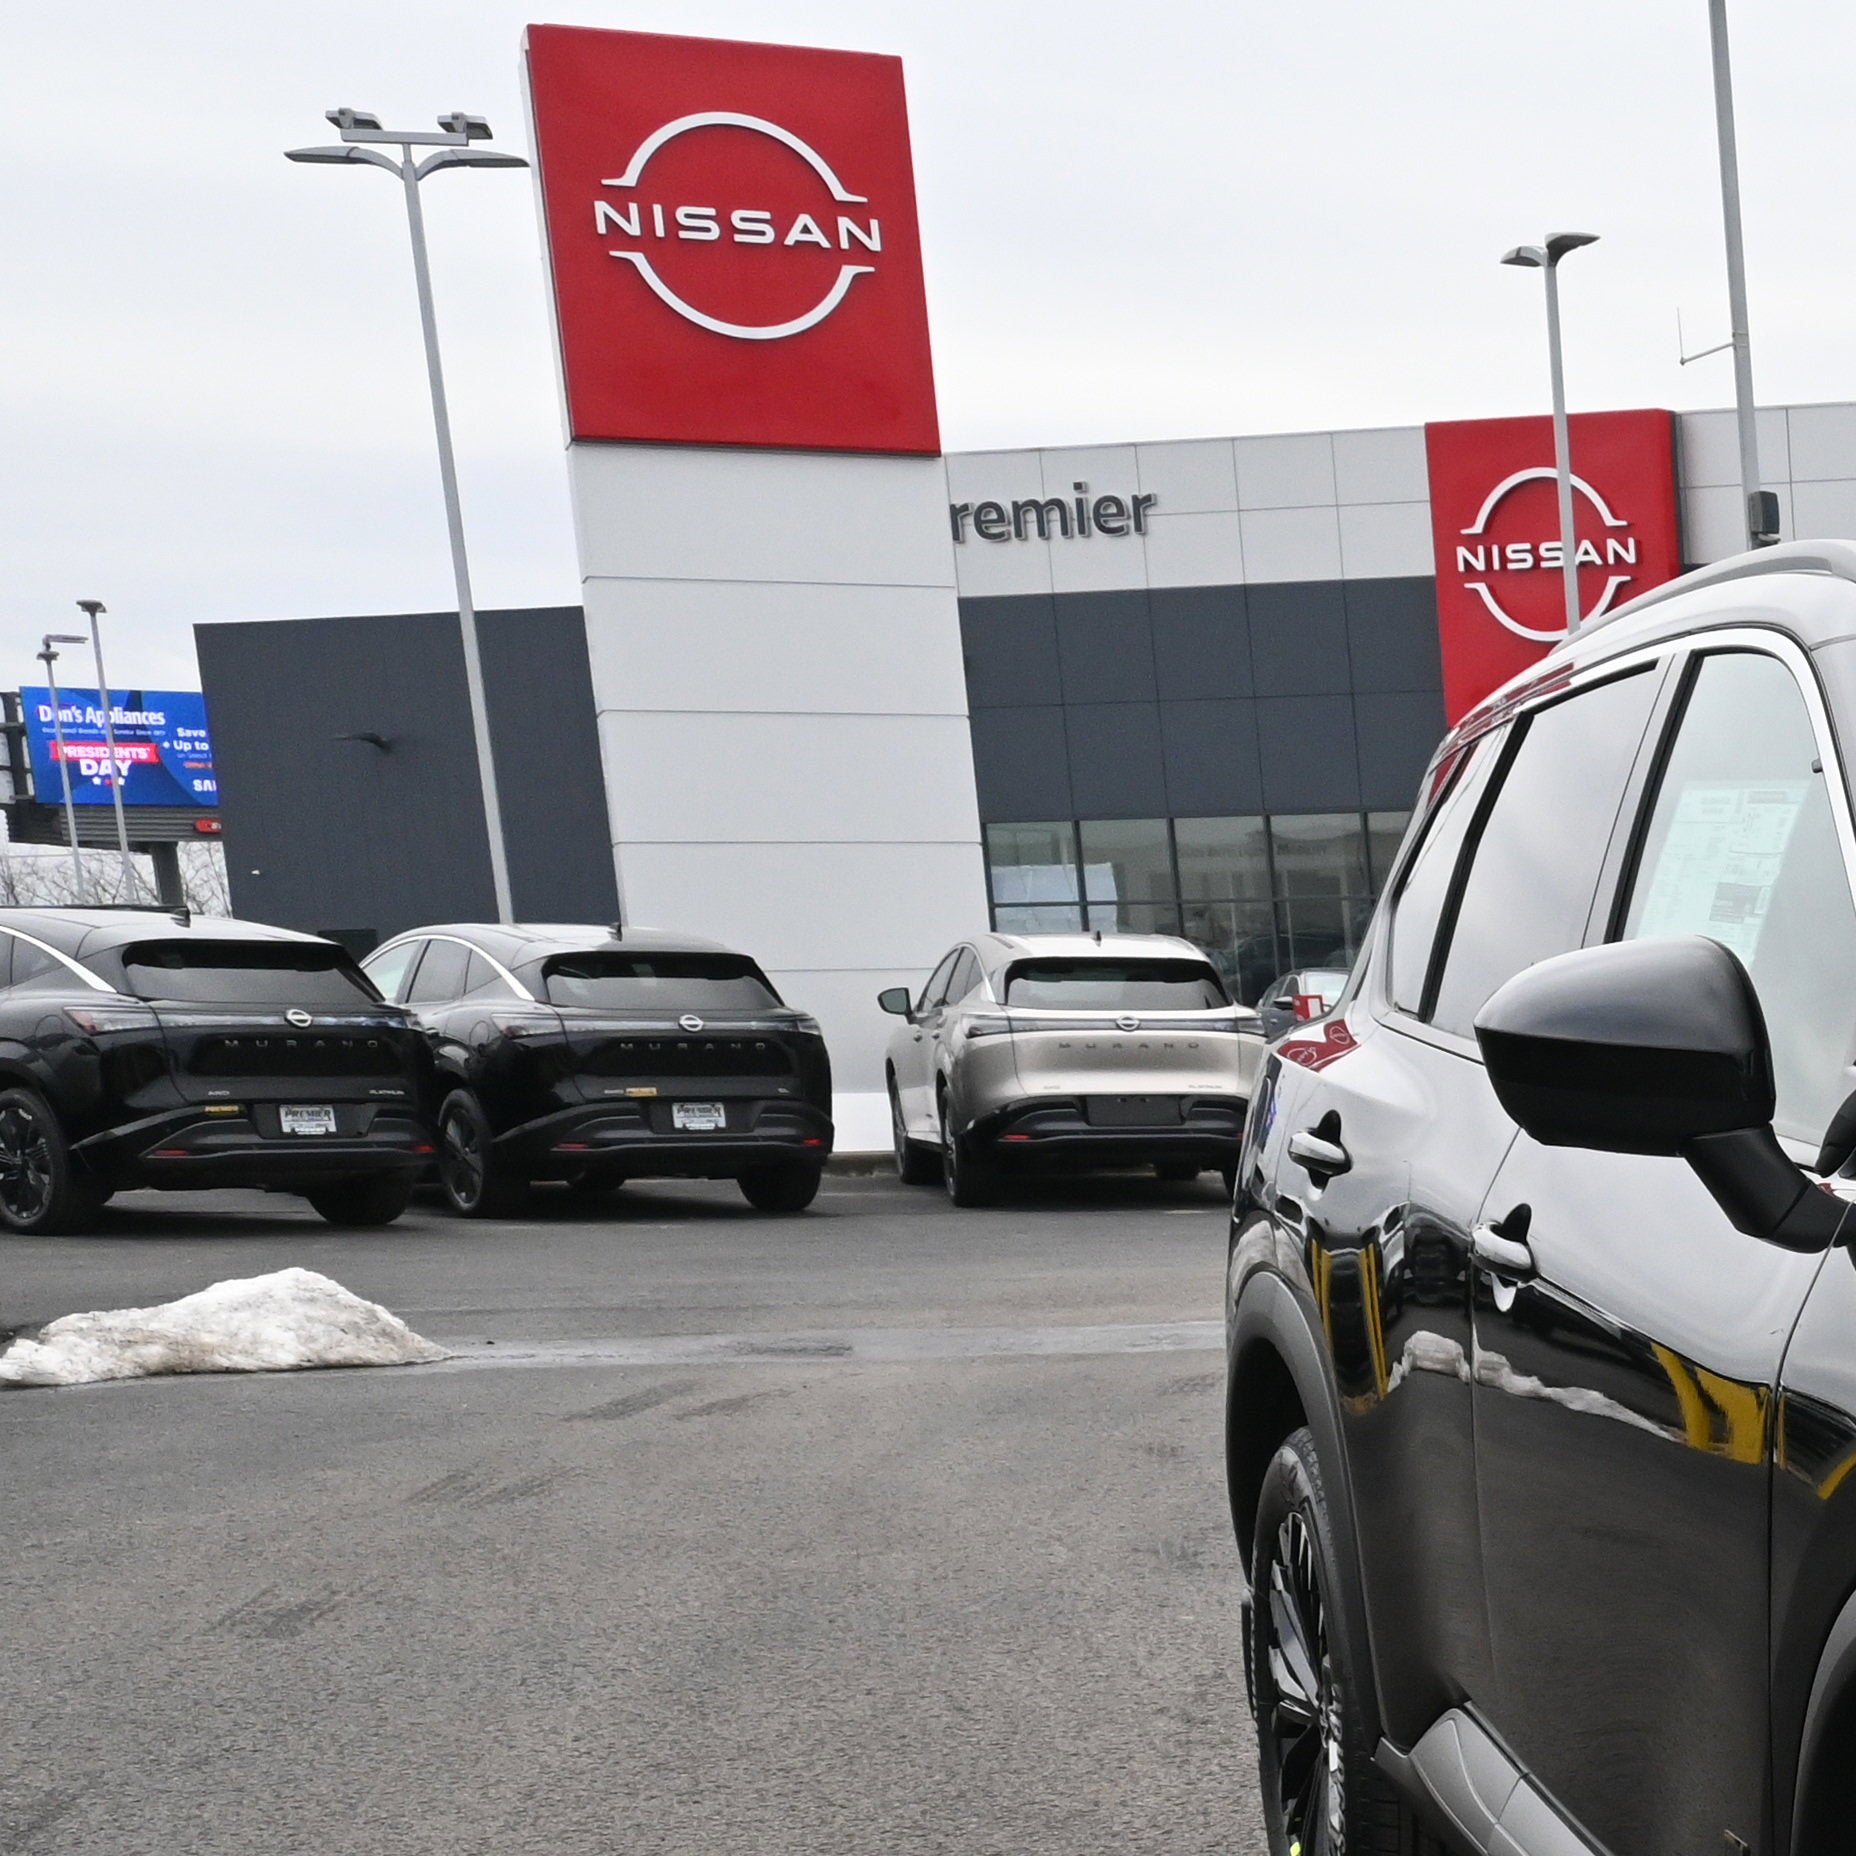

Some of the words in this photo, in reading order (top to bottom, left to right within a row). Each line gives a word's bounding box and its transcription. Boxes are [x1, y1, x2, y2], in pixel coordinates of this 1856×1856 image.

[594, 200, 882, 252] NISSAN
[1456, 537, 1637, 572] NISSAN
[176, 727, 206, 738] Save
[173, 740, 192, 752] Up
[194, 741, 210, 751] to
[79, 759, 132, 776] DAY
[225, 1039, 378, 1047] MURANO
[620, 1042, 766, 1050] MURANO
[284, 1108, 332, 1121] PREMIER
